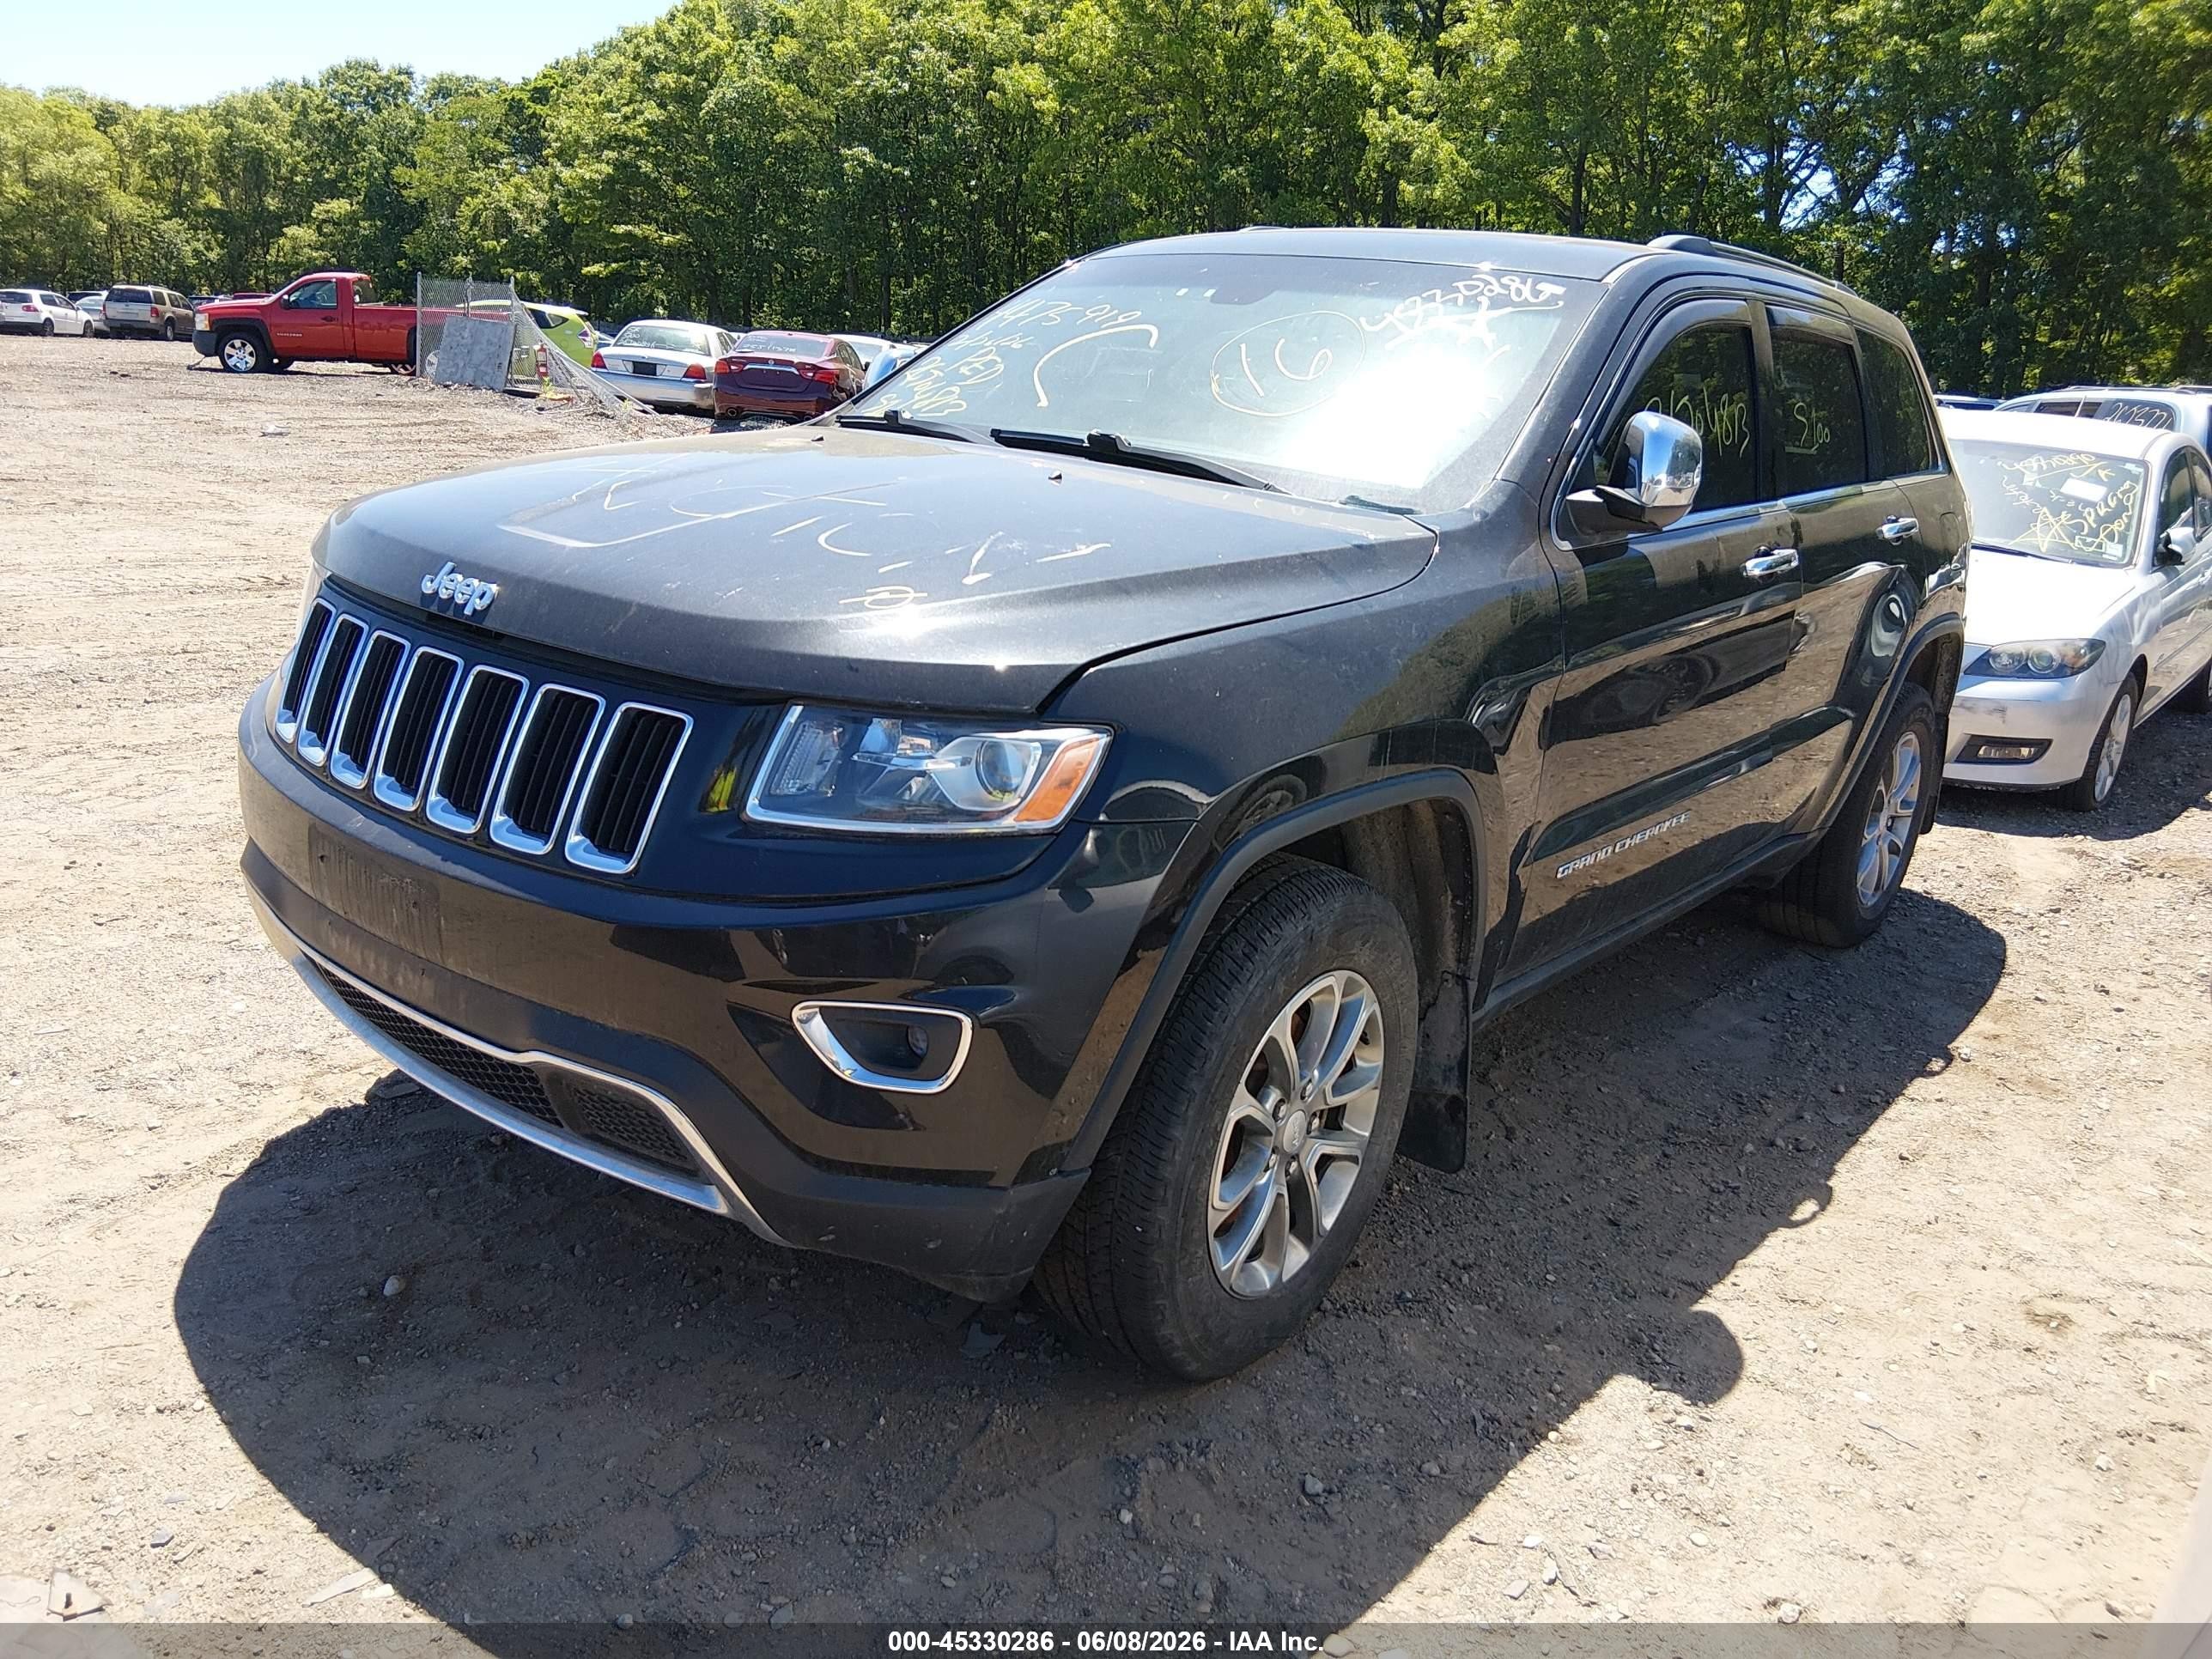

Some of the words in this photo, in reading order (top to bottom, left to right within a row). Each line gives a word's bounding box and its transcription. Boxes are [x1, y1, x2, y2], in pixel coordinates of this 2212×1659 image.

[1239, 337, 1333, 398] 16
[421, 561, 500, 617] Jeep
[1556, 845, 1612, 879] GRAND
[1613, 811, 1692, 854] CHEROKEE
